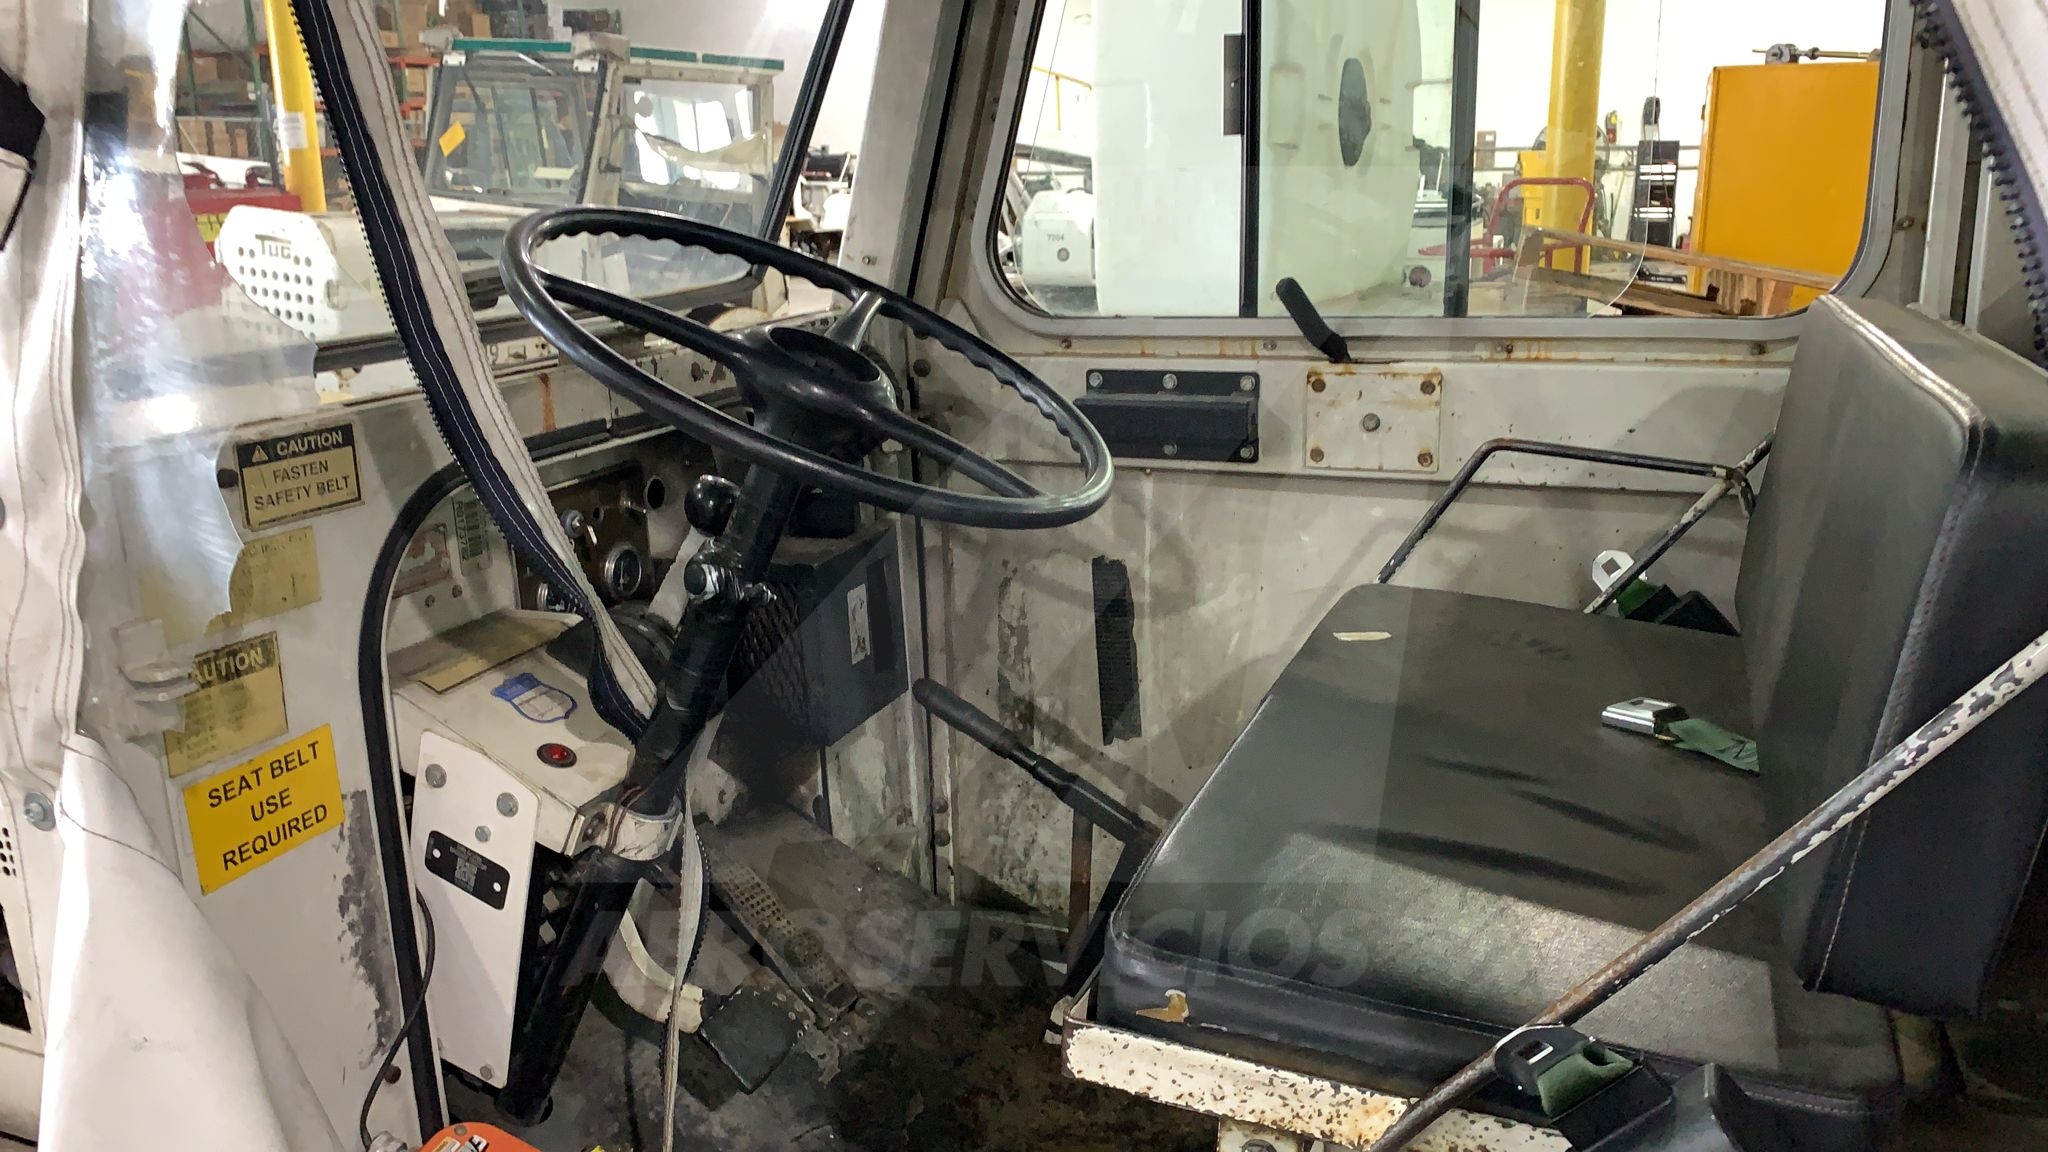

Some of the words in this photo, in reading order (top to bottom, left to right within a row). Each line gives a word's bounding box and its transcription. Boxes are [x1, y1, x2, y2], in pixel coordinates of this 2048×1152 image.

[277, 430, 342, 456] CAUTION
[273, 460, 328, 483] FASTEN
[255, 484, 311, 510] SAFETY
[317, 475, 350, 496] BELT
[192, 647, 263, 683] AUTION
[208, 767, 263, 808] SEAT
[270, 740, 319, 779] BELT
[251, 788, 292, 821] USE
[223, 804, 327, 871] REQUIRED
